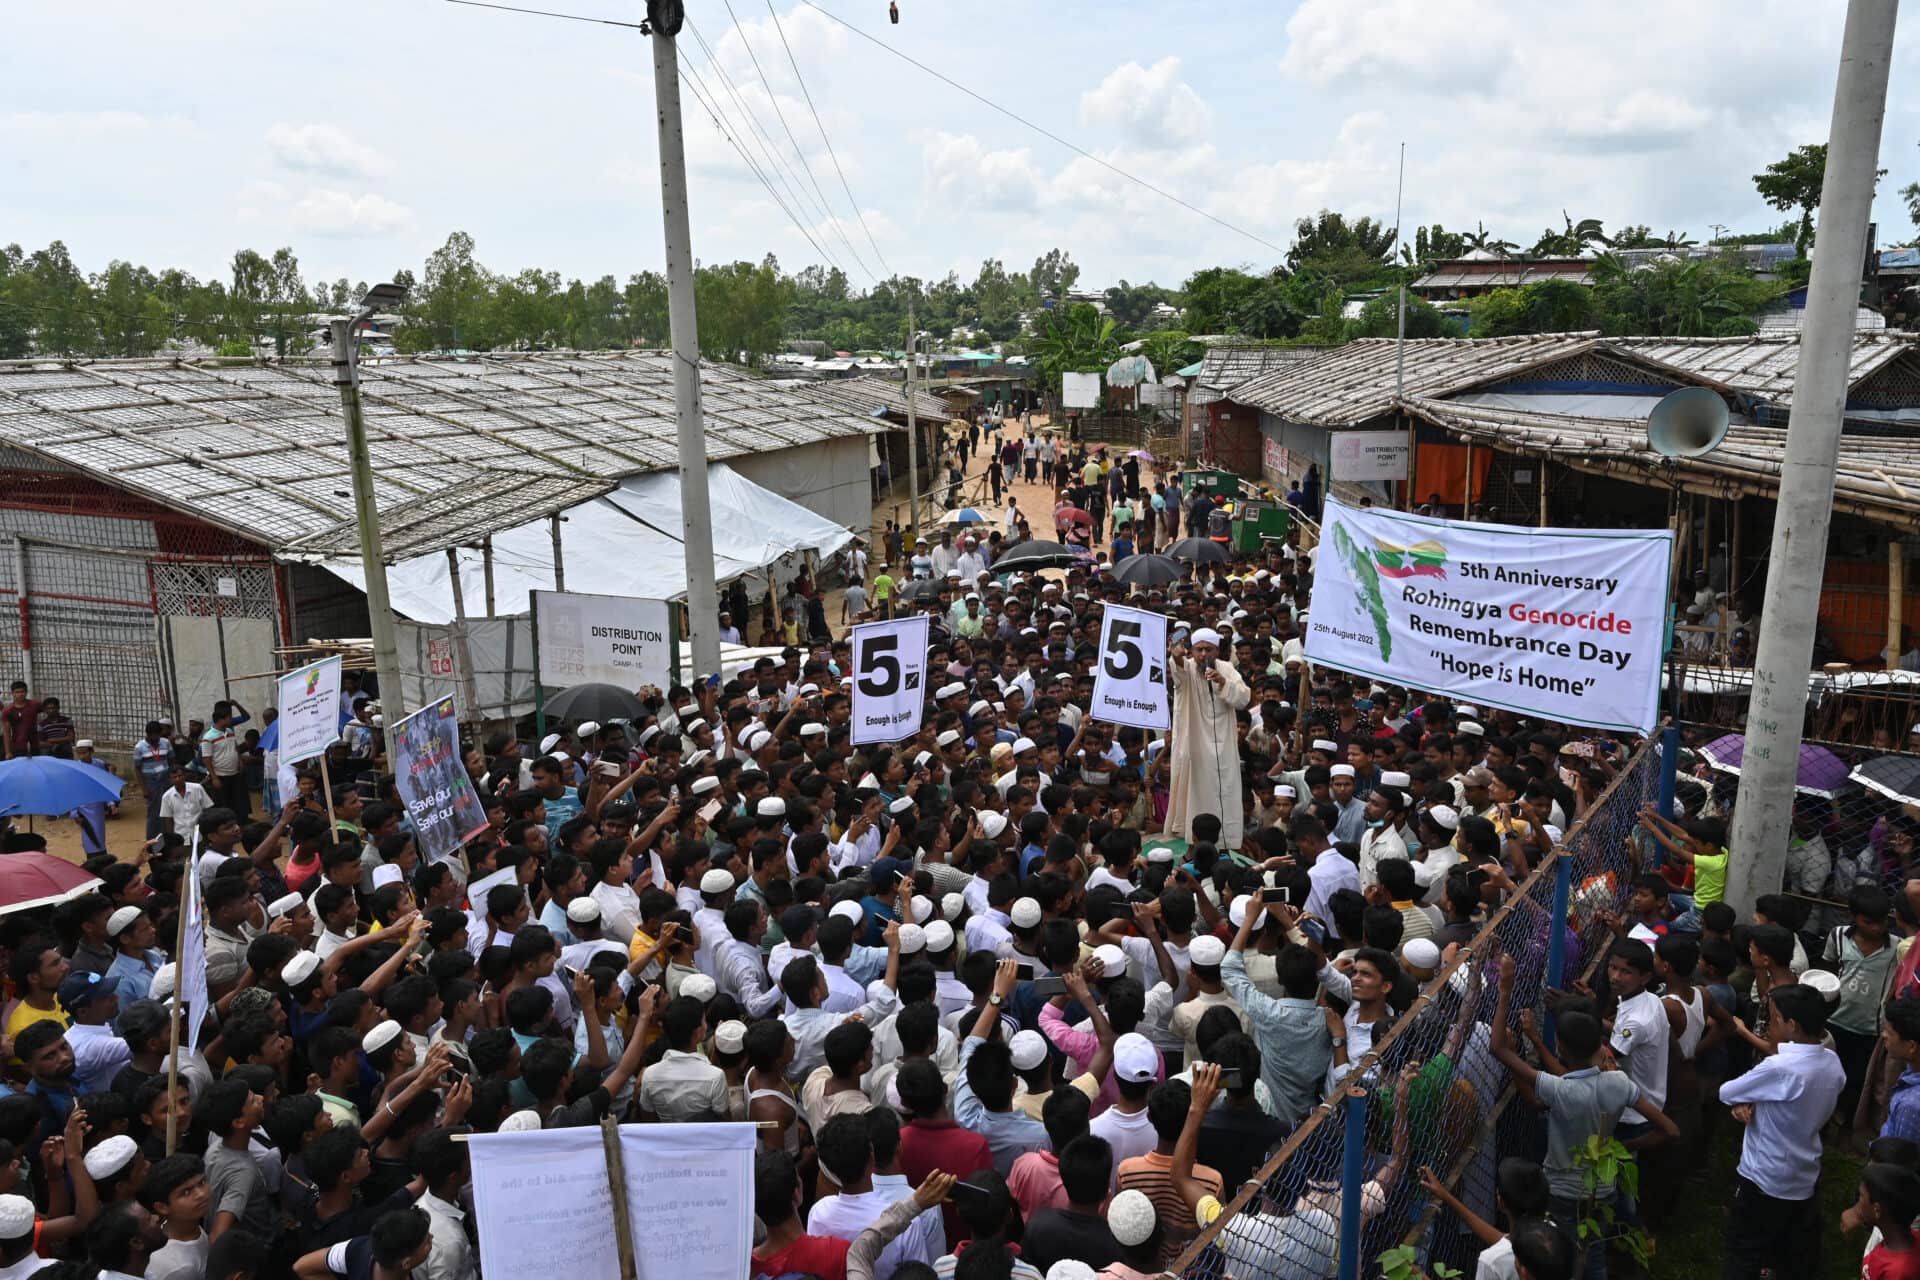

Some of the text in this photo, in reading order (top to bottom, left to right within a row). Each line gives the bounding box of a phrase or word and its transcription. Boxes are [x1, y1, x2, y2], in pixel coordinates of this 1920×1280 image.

[1459, 561, 1618, 595] 5th Anniversary
[1402, 584, 1632, 635] Rohingya Genocide
[592, 626, 662, 642] DISTRIBUTION
[1313, 623, 1374, 646] 25th August 2022
[1409, 614, 1632, 670] Remembrance Day
[612, 643, 642, 656] POINT
[1103, 618, 1143, 680] 5
[857, 634, 900, 697] 5
[1497, 662, 1513, 682] is
[1104, 694, 1157, 713] Enough is Enough
[865, 714, 890, 726] Enough
[409, 794, 434, 815] Save
[435, 786, 451, 802] our
[417, 805, 454, 831] Save our
